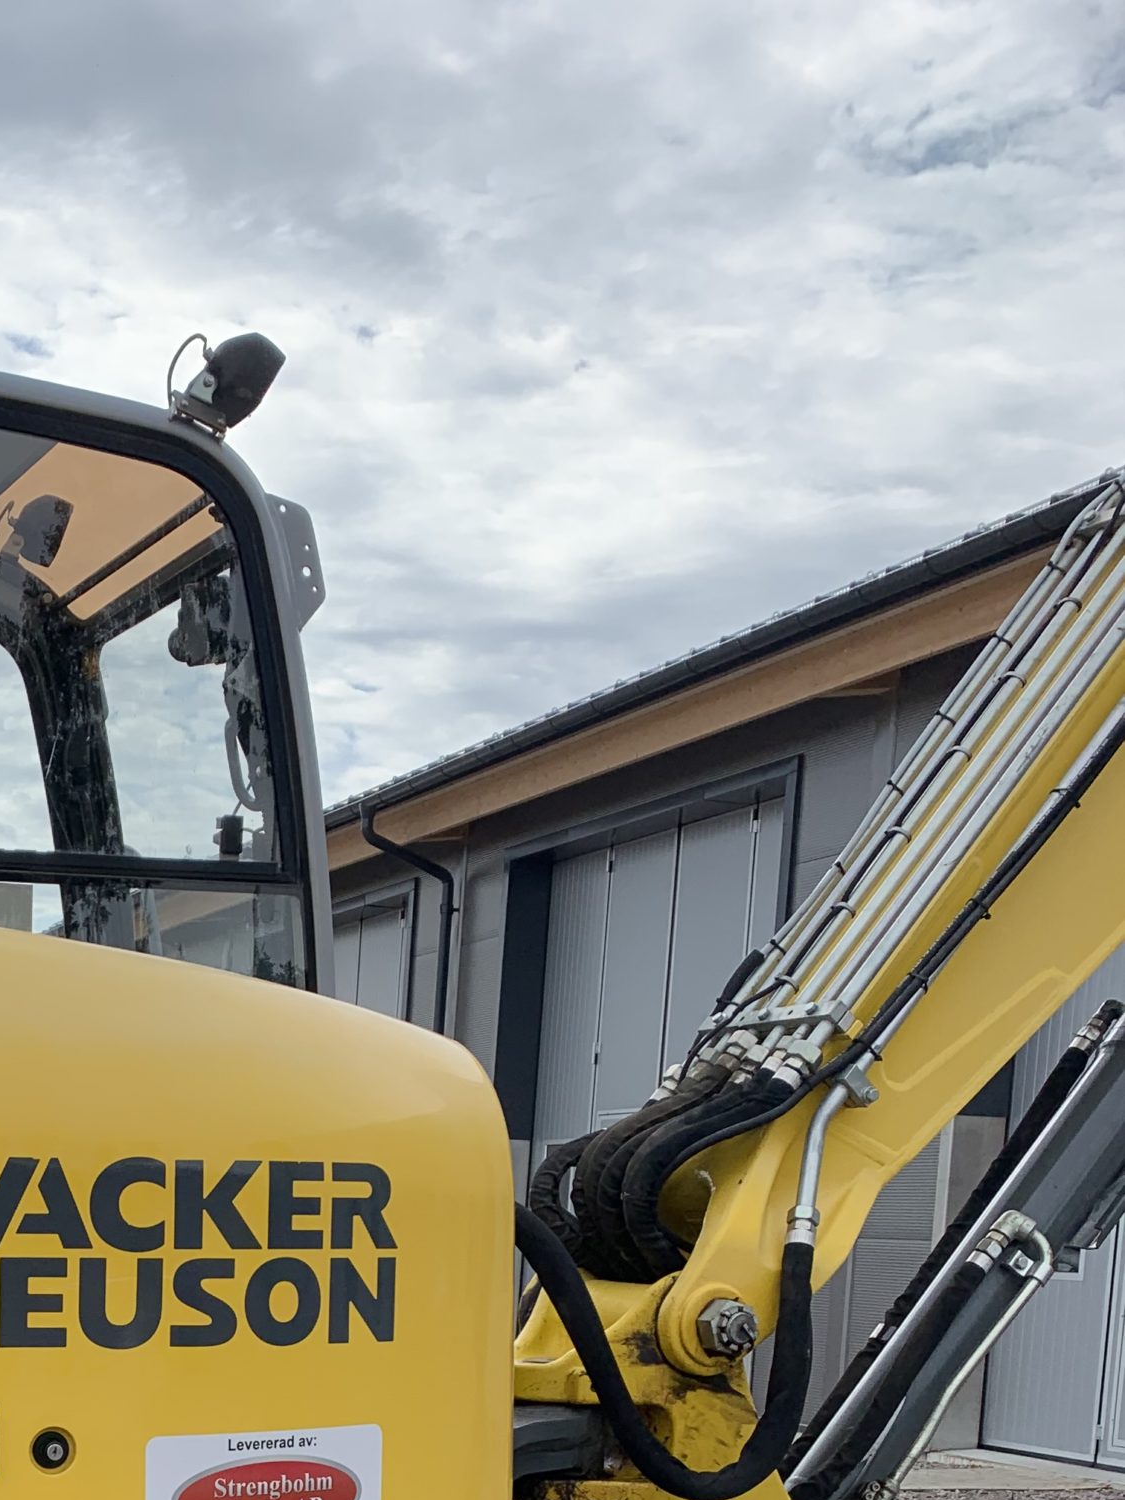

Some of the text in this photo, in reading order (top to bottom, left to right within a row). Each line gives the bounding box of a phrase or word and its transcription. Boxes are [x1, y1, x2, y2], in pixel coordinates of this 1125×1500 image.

[228, 1435, 317, 1452] Levererad av:
[213, 1472, 333, 1500] Strengbohm
